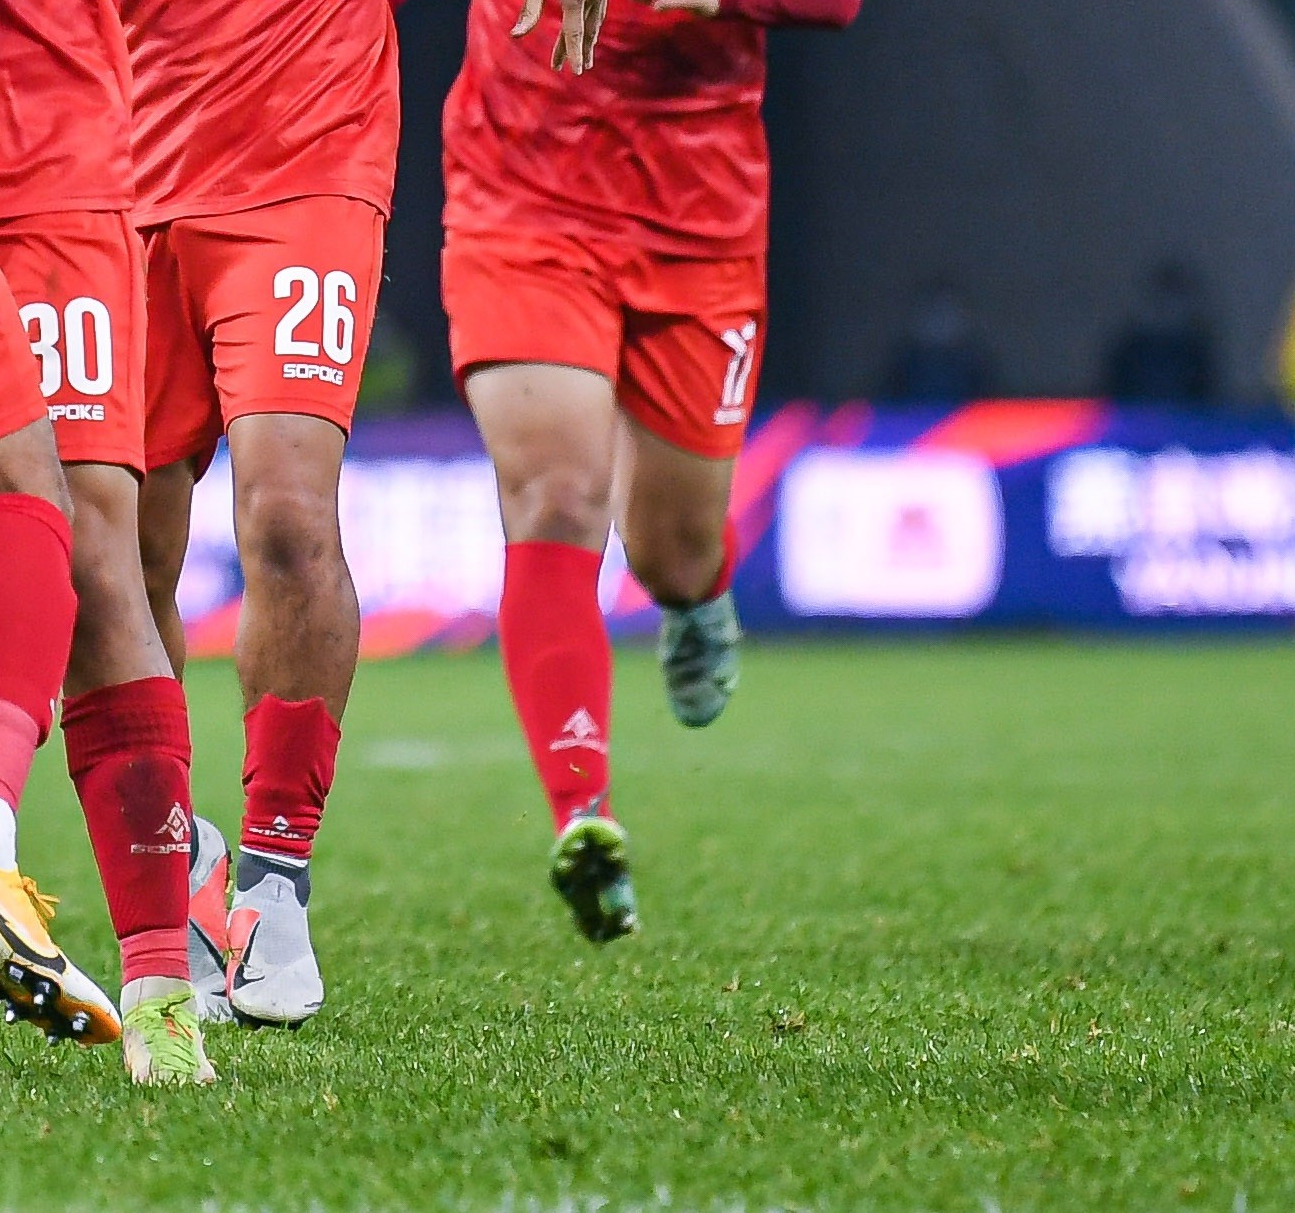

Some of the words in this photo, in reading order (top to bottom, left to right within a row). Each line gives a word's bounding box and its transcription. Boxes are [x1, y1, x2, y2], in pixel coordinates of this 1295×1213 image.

[18, 295, 114, 398] 30
[273, 265, 357, 366] 26
[282, 363, 344, 386] SOPOKE
[46, 403, 105, 422] POKE
